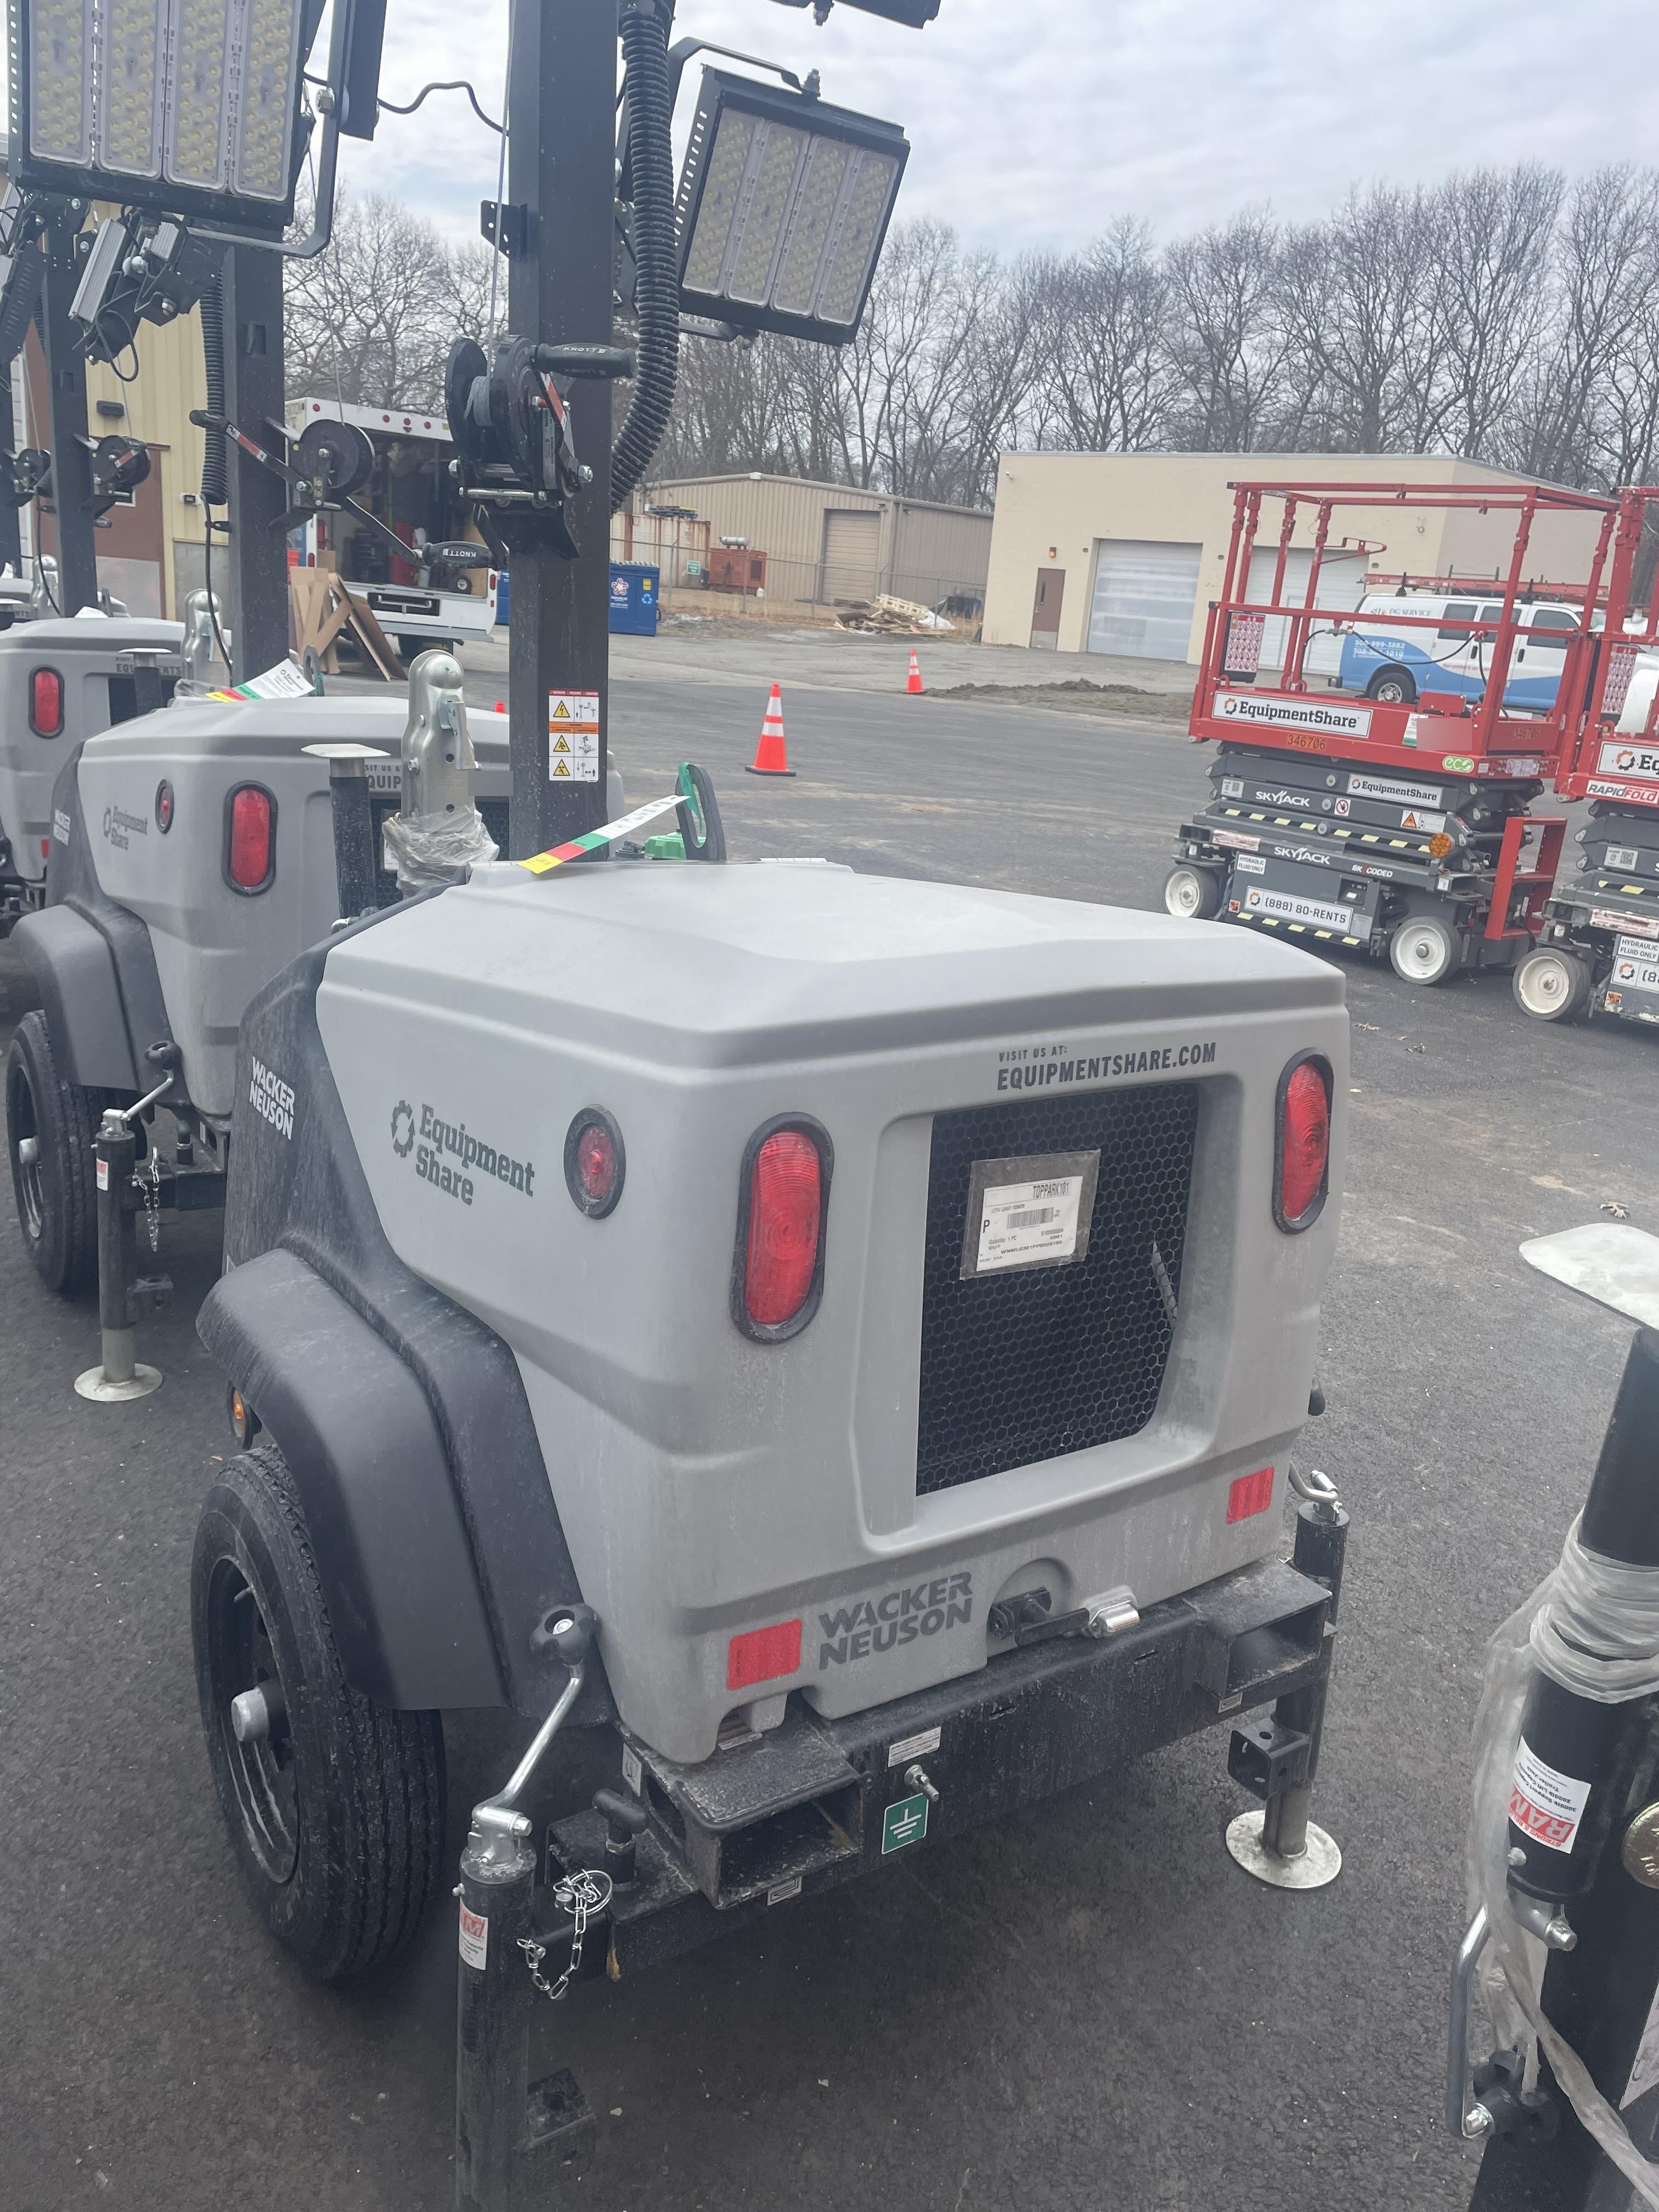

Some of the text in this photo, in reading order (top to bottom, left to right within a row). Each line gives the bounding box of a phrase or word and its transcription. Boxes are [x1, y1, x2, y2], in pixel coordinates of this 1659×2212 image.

[1239, 701, 1357, 729] EquipmentShare
[1287, 734, 1326, 751] 346706
[1513, 727, 1541, 740] 346706
[1255, 790, 1310, 807] SKYJACK
[1362, 781, 1437, 801] EquipmentShare
[1239, 856, 1266, 866] HYDRAULIC
[1274, 847, 1331, 865] SKYJACK
[1265, 896, 1347, 923] (888) 80-RENTS
[1620, 947, 1657, 959] FLUID ONLY
[1622, 939, 1658, 951] HYDRAULIC
[998, 1046, 1068, 1062] VISIT US AT:
[997, 1042, 1216, 1091] EQUIPMENTSHARE.COM
[252, 1056, 295, 1116] WACKER
[249, 1080, 294, 1141] NEUSON
[419, 1103, 535, 1198] Equipment
[416, 1146, 474, 1205] Share
[983, 1219, 990, 1233] P
[819, 1571, 973, 1639] WACKER
[819, 1597, 972, 1671] NEUSON
